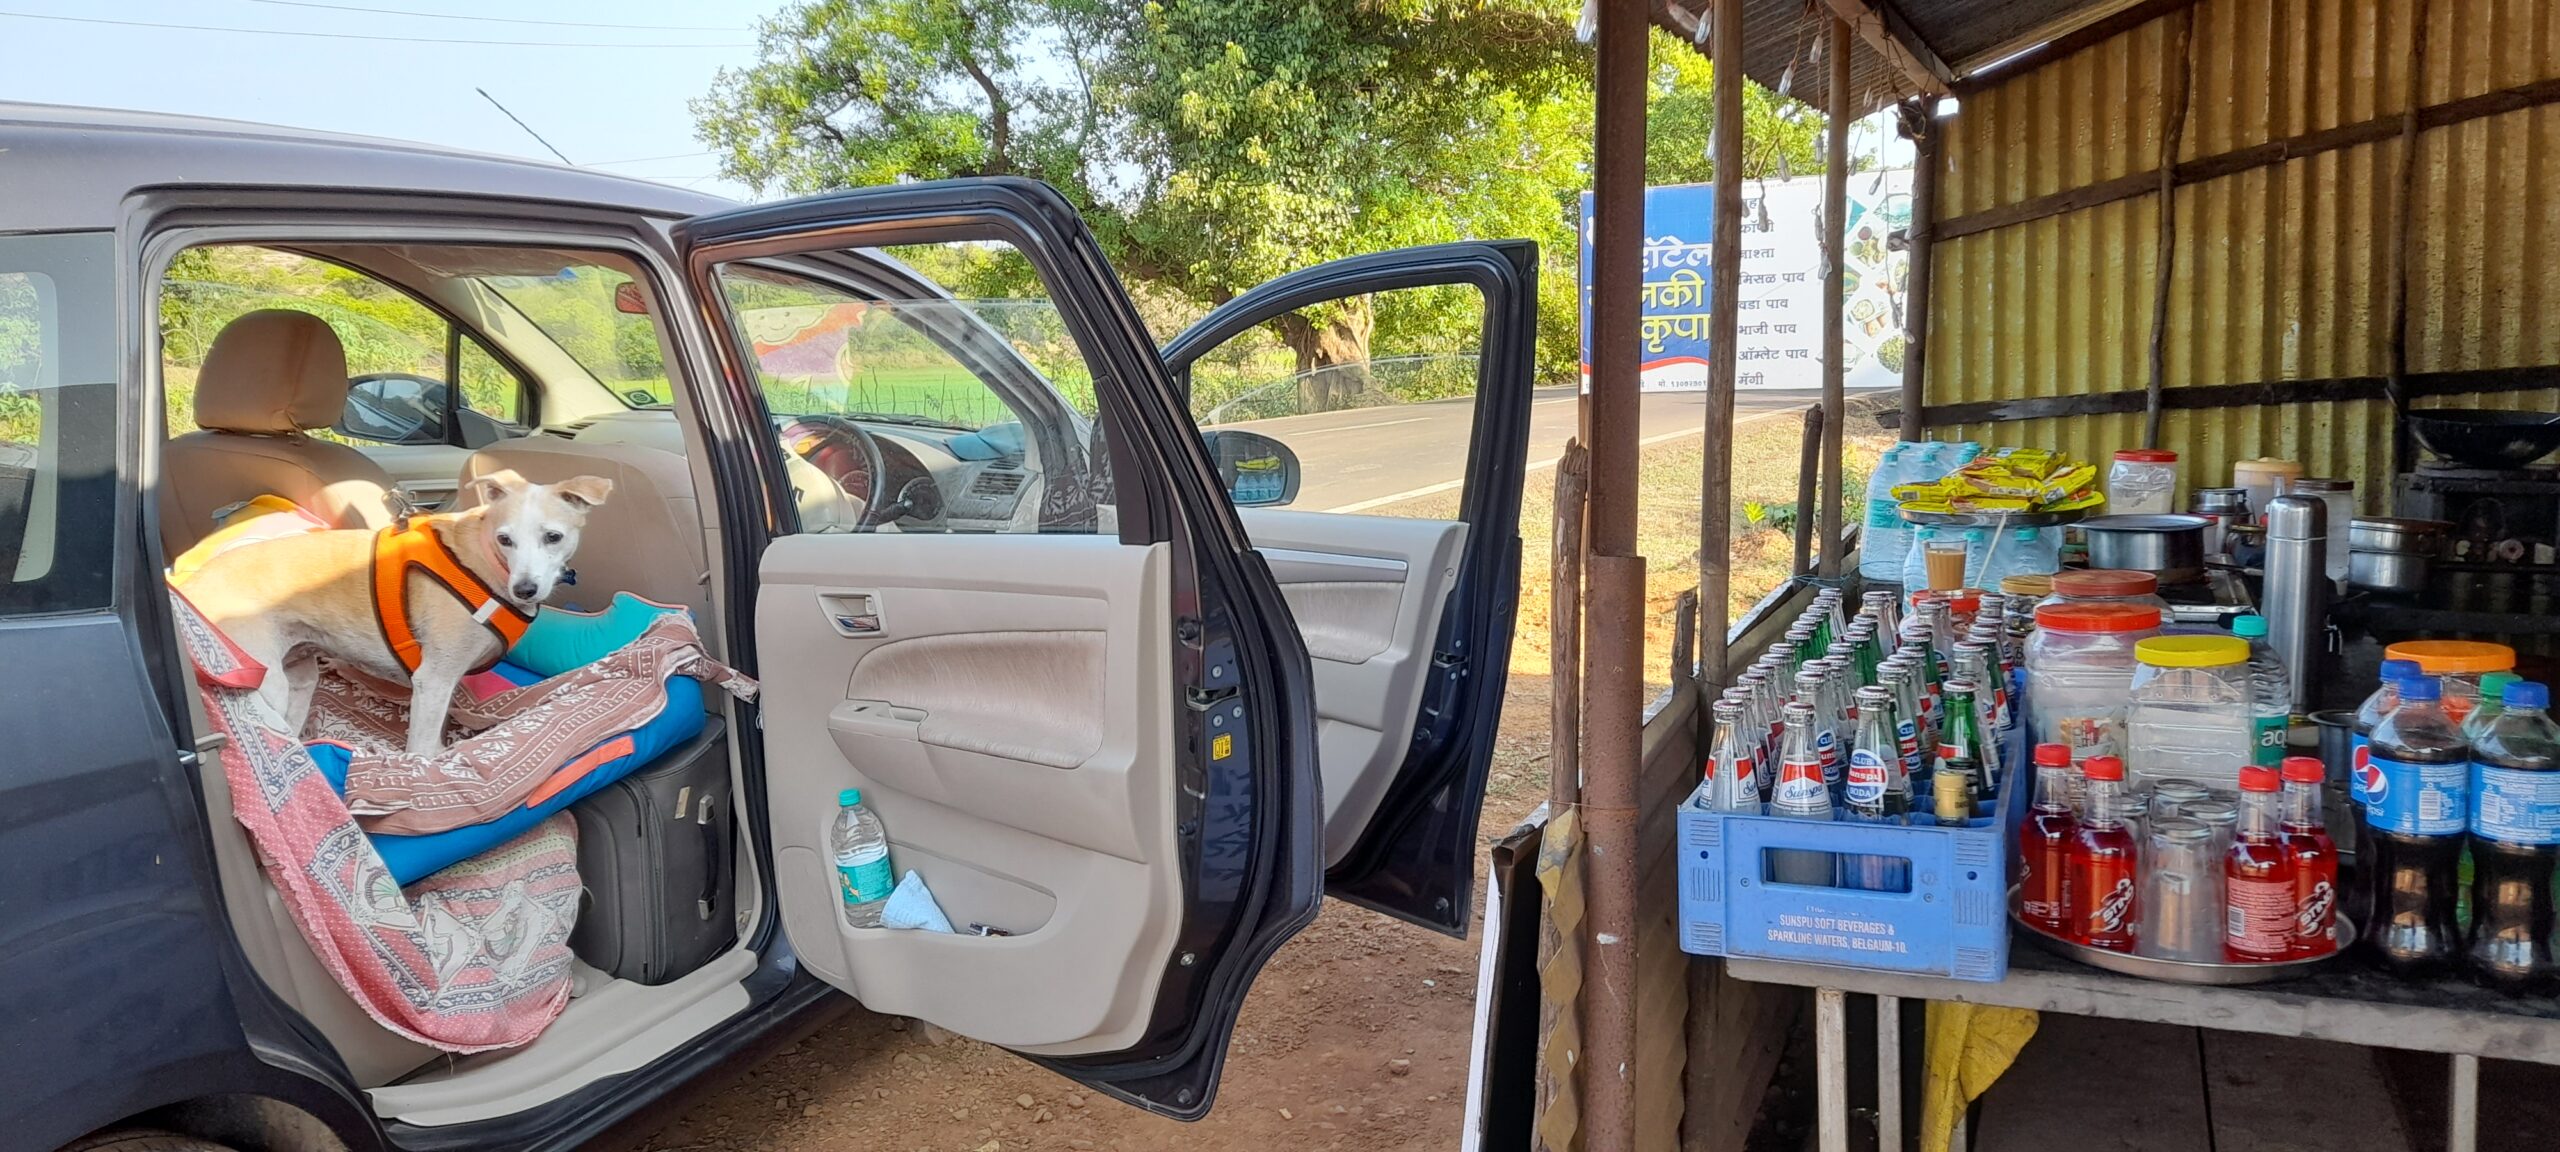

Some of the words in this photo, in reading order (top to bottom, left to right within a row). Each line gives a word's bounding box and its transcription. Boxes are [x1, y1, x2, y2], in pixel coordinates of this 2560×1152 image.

[1738, 271, 1776, 285] मिसळ
[1782, 272, 1805, 282] पाव
[1738, 299, 1760, 310] वडा
[1766, 298, 1789, 308] पाव
[1641, 313, 1711, 353] कृपा
[1738, 321, 1768, 335] भाजी
[1774, 324, 1797, 333] पाव
[1785, 349, 1809, 359] पाव
[1853, 755, 1877, 766] CLUB
[1850, 786, 1871, 797] SODA
[1779, 914, 1813, 928] SUNSPU
[1815, 917, 1836, 930] SOFT
[1837, 919, 1886, 935] BEVERAGES
[1887, 924, 1895, 935] &
[1768, 929, 1812, 945] SPARKLING
[1814, 934, 1850, 949] WATERS,
